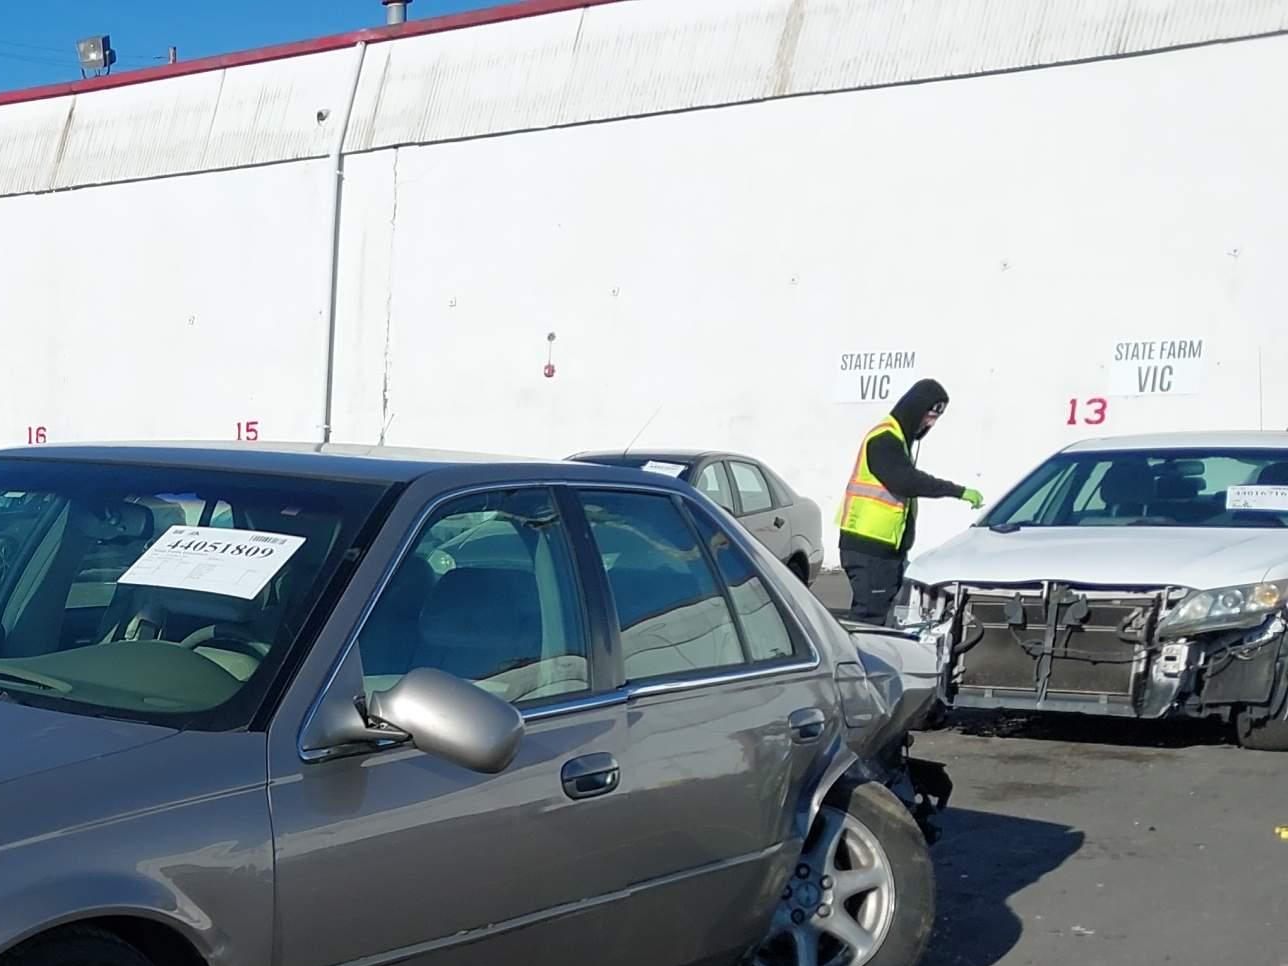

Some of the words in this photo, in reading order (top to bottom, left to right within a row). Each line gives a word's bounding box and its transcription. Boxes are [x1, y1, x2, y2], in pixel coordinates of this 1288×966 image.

[840, 352, 876, 371] STATE
[878, 351, 916, 370] FARM
[1114, 340, 1157, 361] STATE
[1159, 339, 1203, 360] FARM
[860, 374, 891, 401] VIC
[1137, 364, 1174, 393] VIC
[1066, 397, 1108, 426] 13
[28, 426, 47, 445] 16
[237, 421, 259, 441] 15
[167, 538, 275, 560] 44051809
